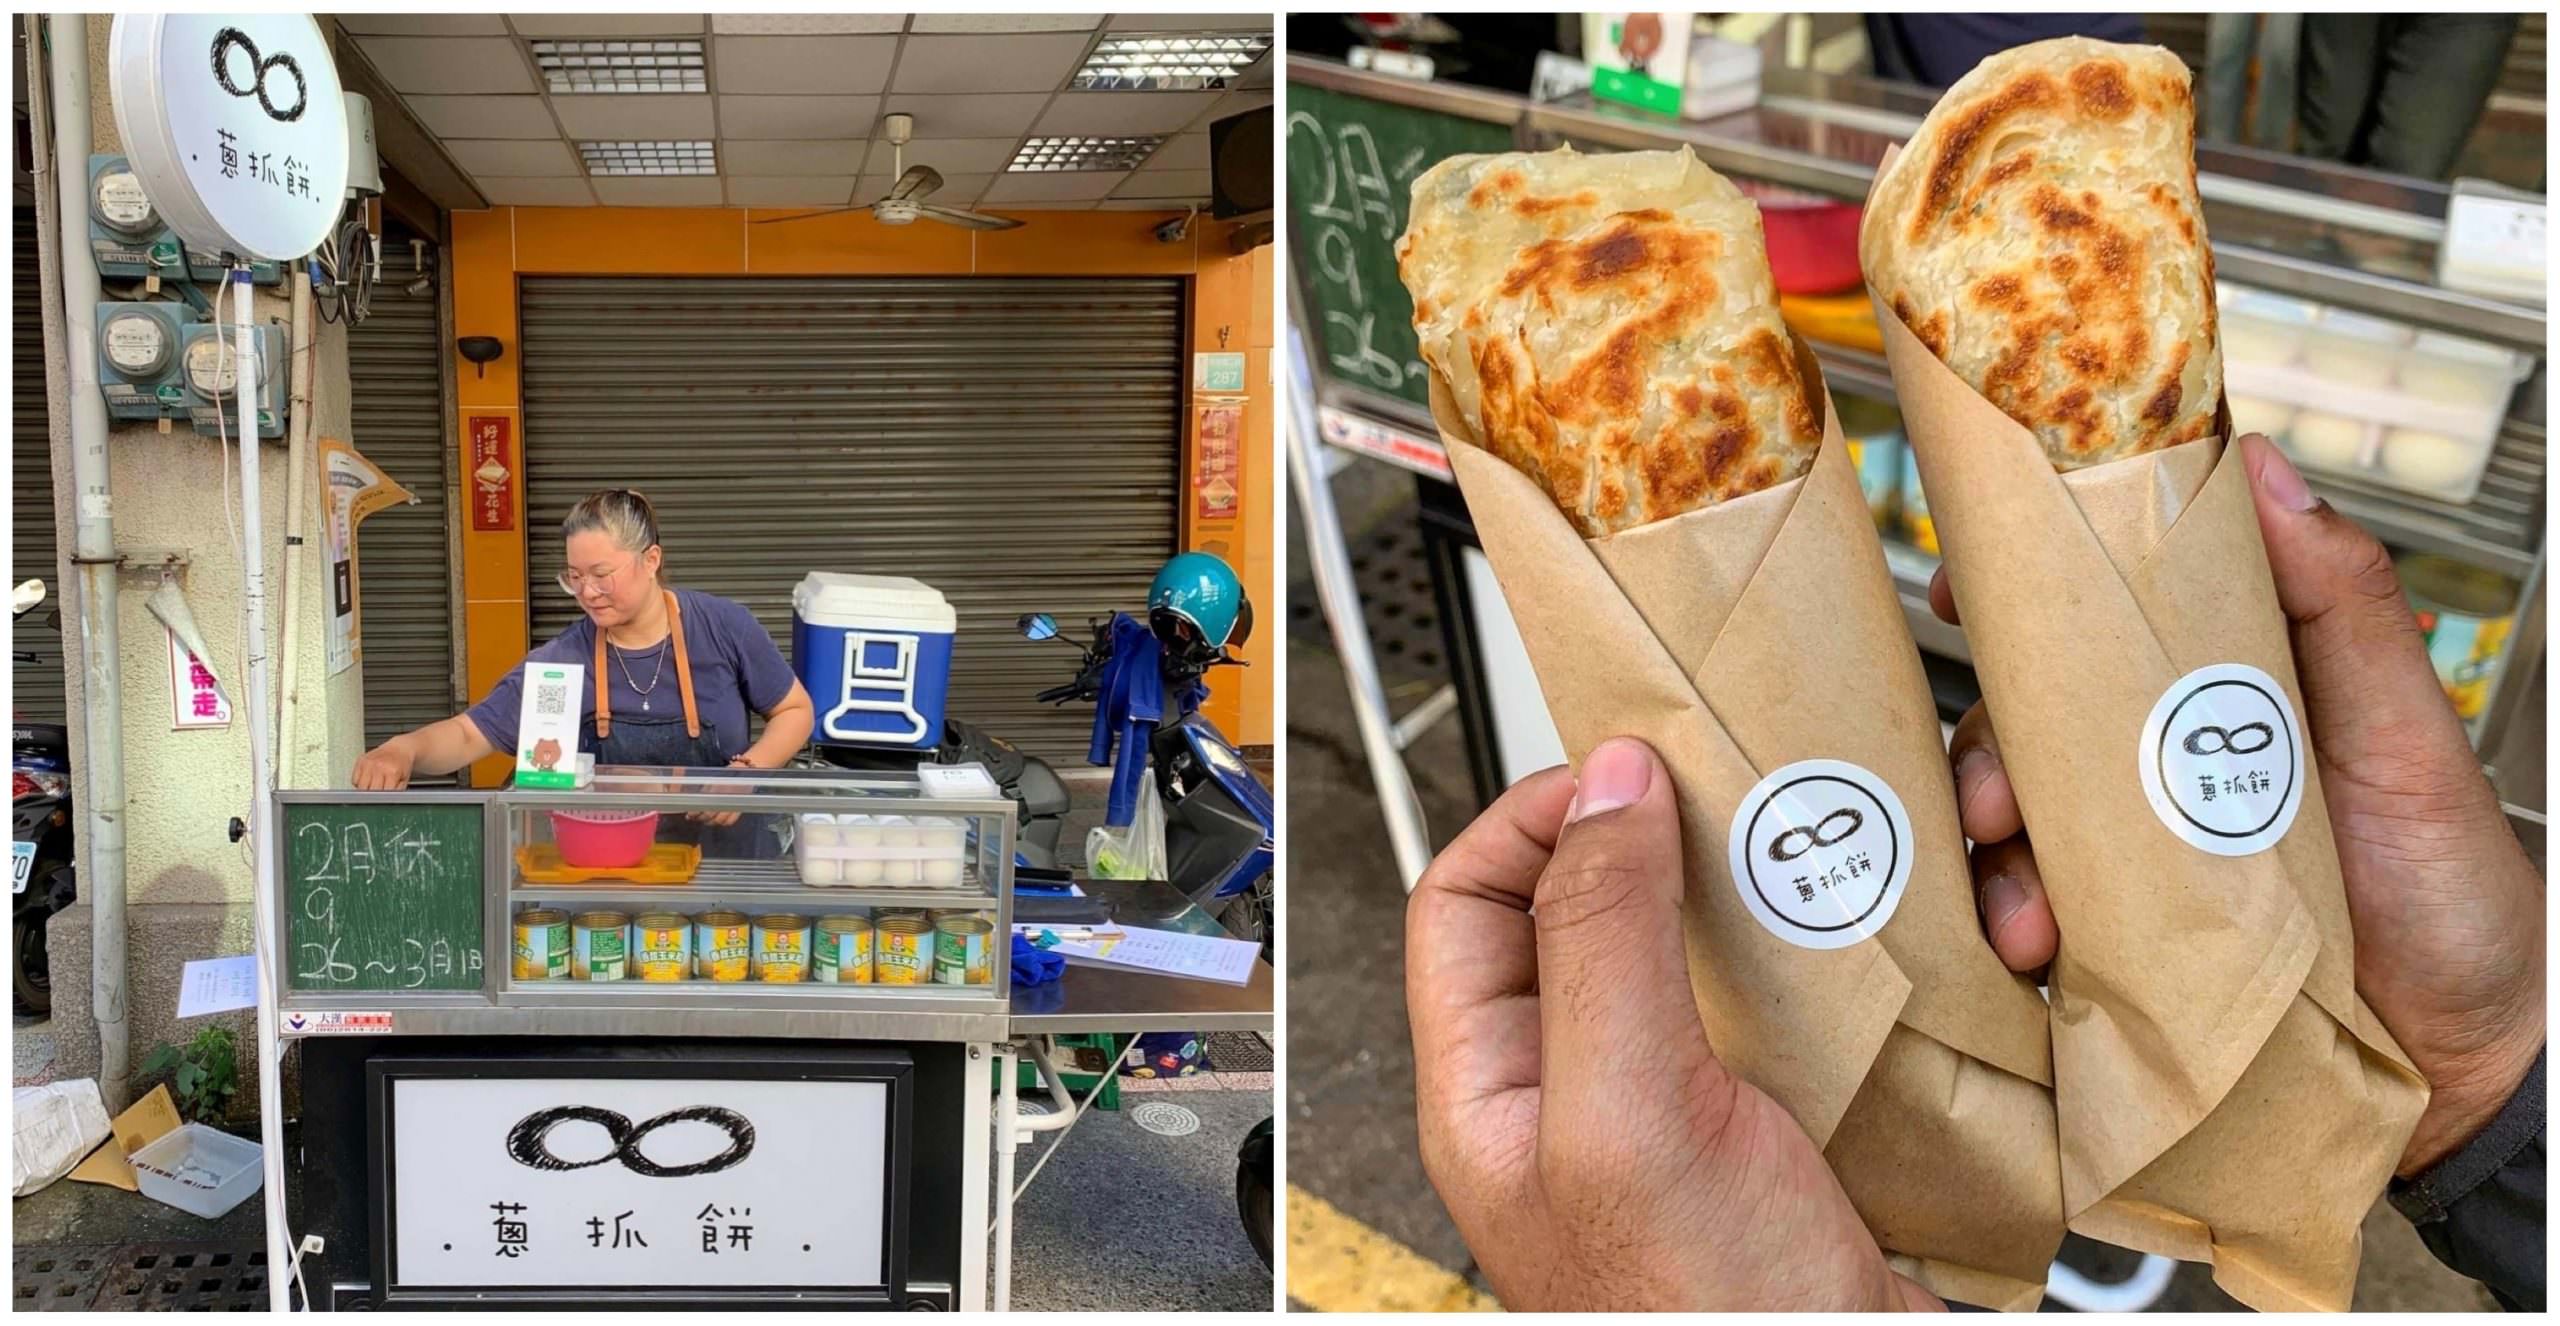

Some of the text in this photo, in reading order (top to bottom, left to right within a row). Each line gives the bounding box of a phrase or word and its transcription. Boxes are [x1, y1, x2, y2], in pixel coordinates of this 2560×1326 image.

[217, 128, 310, 199] 蔥抓餅
[1317, 224, 1363, 308] 9
[2198, 770, 2270, 802] 蔥抓餅
[300, 822, 444, 890] 2月休
[1792, 851, 1872, 903] 蔥抓餅
[305, 886, 333, 935] 9
[490, 1201, 753, 1258] 蔥抓餅
